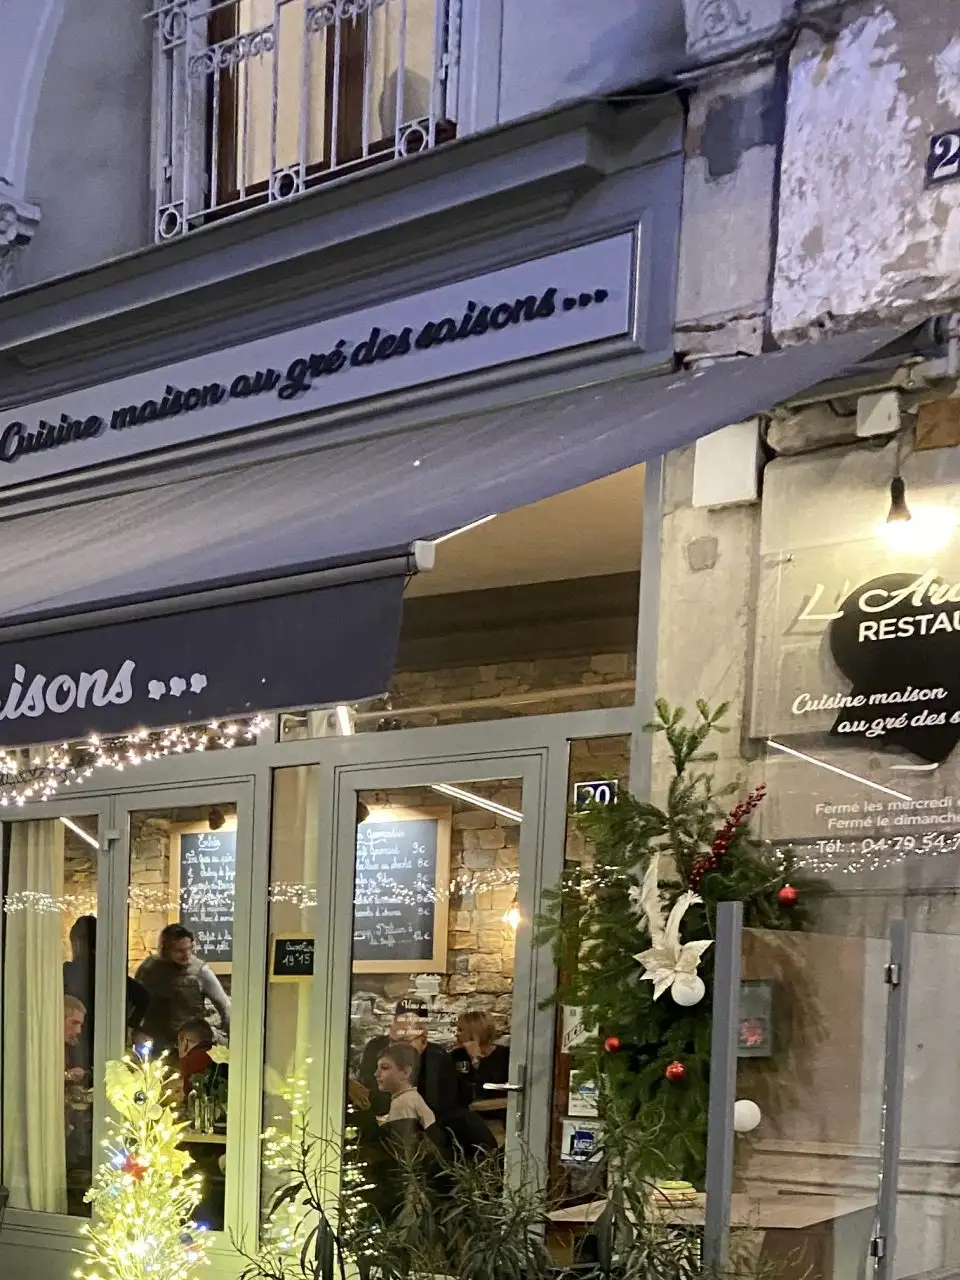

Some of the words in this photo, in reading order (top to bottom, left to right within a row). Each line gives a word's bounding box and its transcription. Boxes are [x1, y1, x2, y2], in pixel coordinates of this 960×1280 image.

[110, 385, 227, 430] maison
[230, 368, 280, 398] au
[278, 339, 348, 400] gré
[350, 327, 413, 366] des
[792, 693, 866, 715] Cuisine
[869, 685, 948, 705] maison
[837, 719, 869, 733] au
[865, 713, 909, 738] gré
[910, 710, 946, 727] des
[815, 802, 859, 815] Fermé
[863, 801, 883, 813] les
[888, 796, 952, 811] mercredi
[828, 817, 873, 829] Fermé
[876, 816, 889, 827] le
[892, 836, 915, 850] 79
